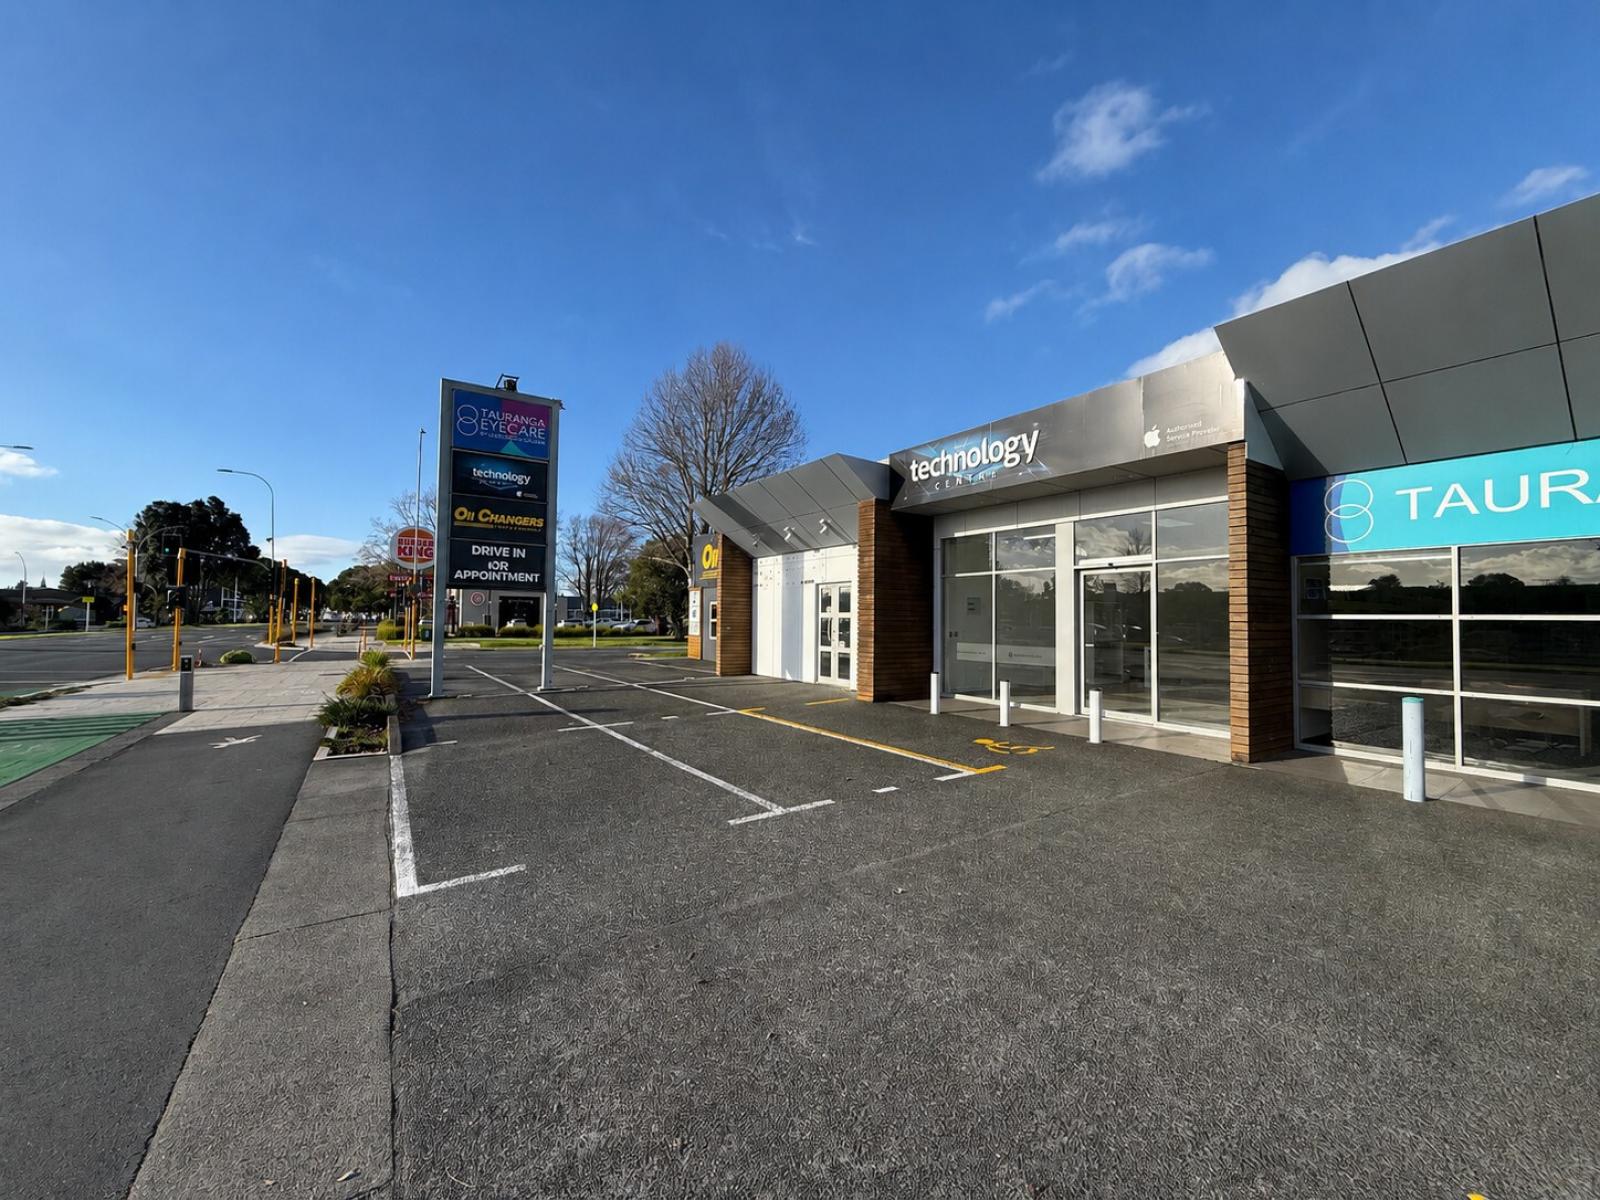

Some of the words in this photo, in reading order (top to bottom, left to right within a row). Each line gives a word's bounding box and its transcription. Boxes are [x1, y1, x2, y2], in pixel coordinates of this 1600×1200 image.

[481, 408, 546, 428] TAURANGA
[481, 418, 546, 440] EYECARE
[910, 429, 1040, 482] technology
[472, 467, 531, 485] technology
[935, 471, 998, 491] CENTRE
[1395, 468, 1600, 520] TAUR
[478, 508, 545, 528] CHANGERS
[397, 546, 434, 558] KING
[471, 544, 511, 558] DRIVE
[513, 547, 526, 559] IN
[454, 569, 541, 583] APPOINTMENT
